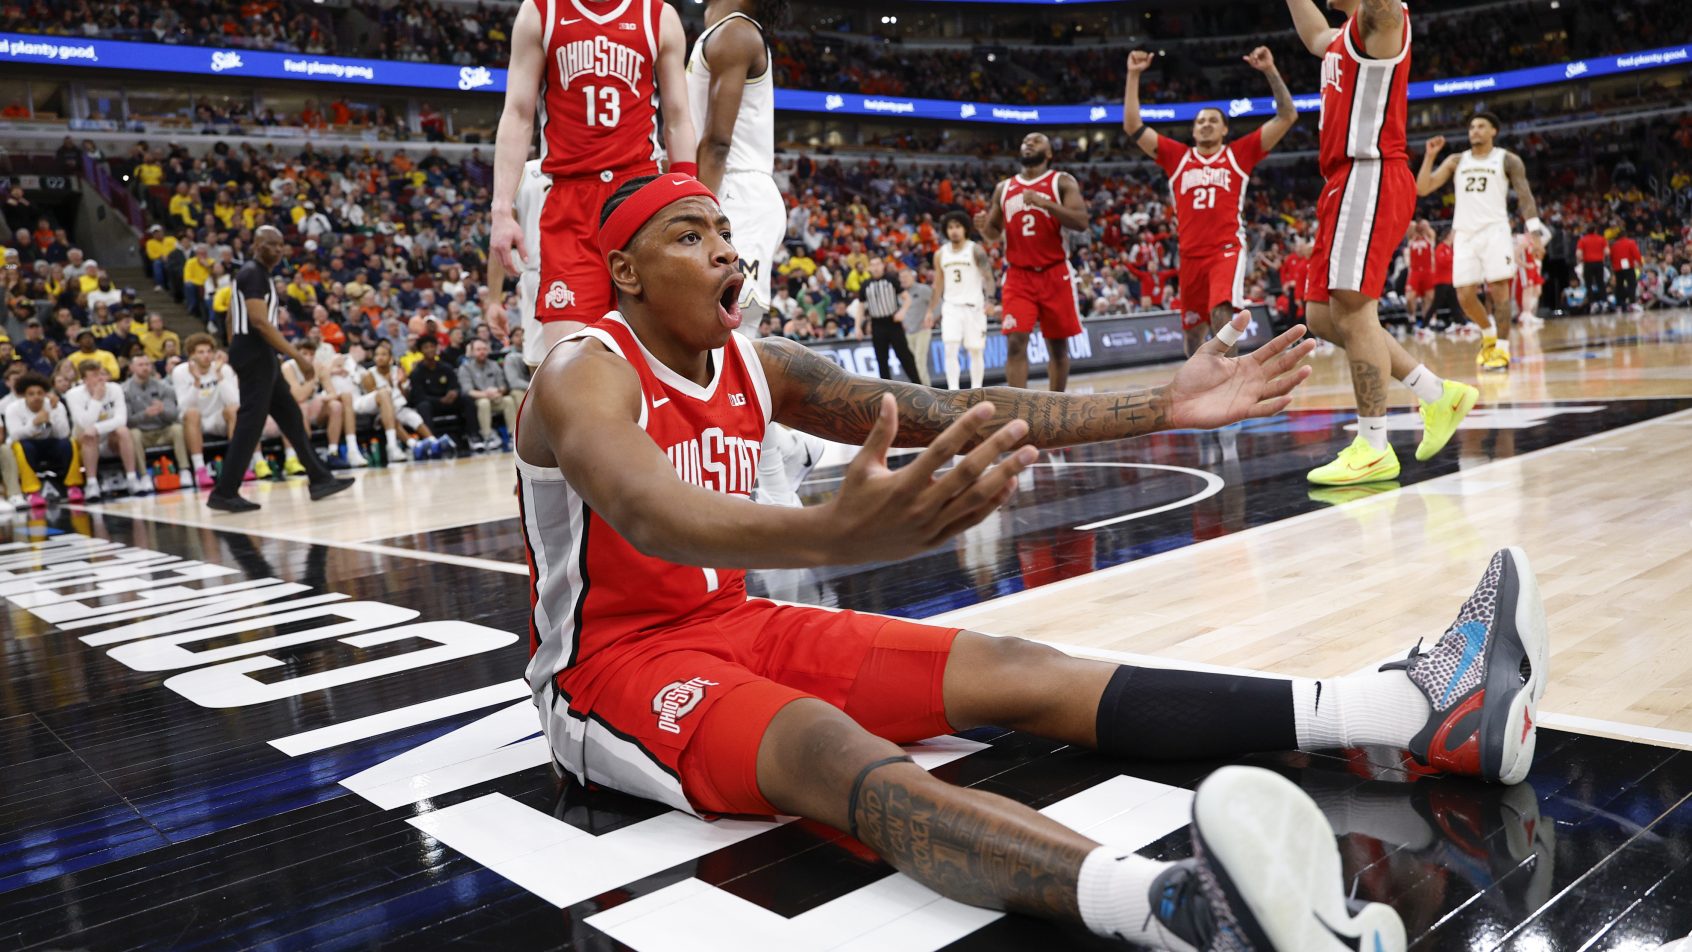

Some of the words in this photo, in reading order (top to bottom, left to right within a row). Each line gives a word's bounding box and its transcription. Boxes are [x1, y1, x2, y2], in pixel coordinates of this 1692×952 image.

[210, 51, 244, 72] Silk
[458, 66, 494, 90] Silk
[582, 85, 620, 127] 13
[1465, 177, 1488, 192] 23
[1193, 187, 1216, 209] 21
[1022, 213, 1036, 236] 2
[953, 269, 962, 283] 3
[700, 426, 762, 497] STAT
